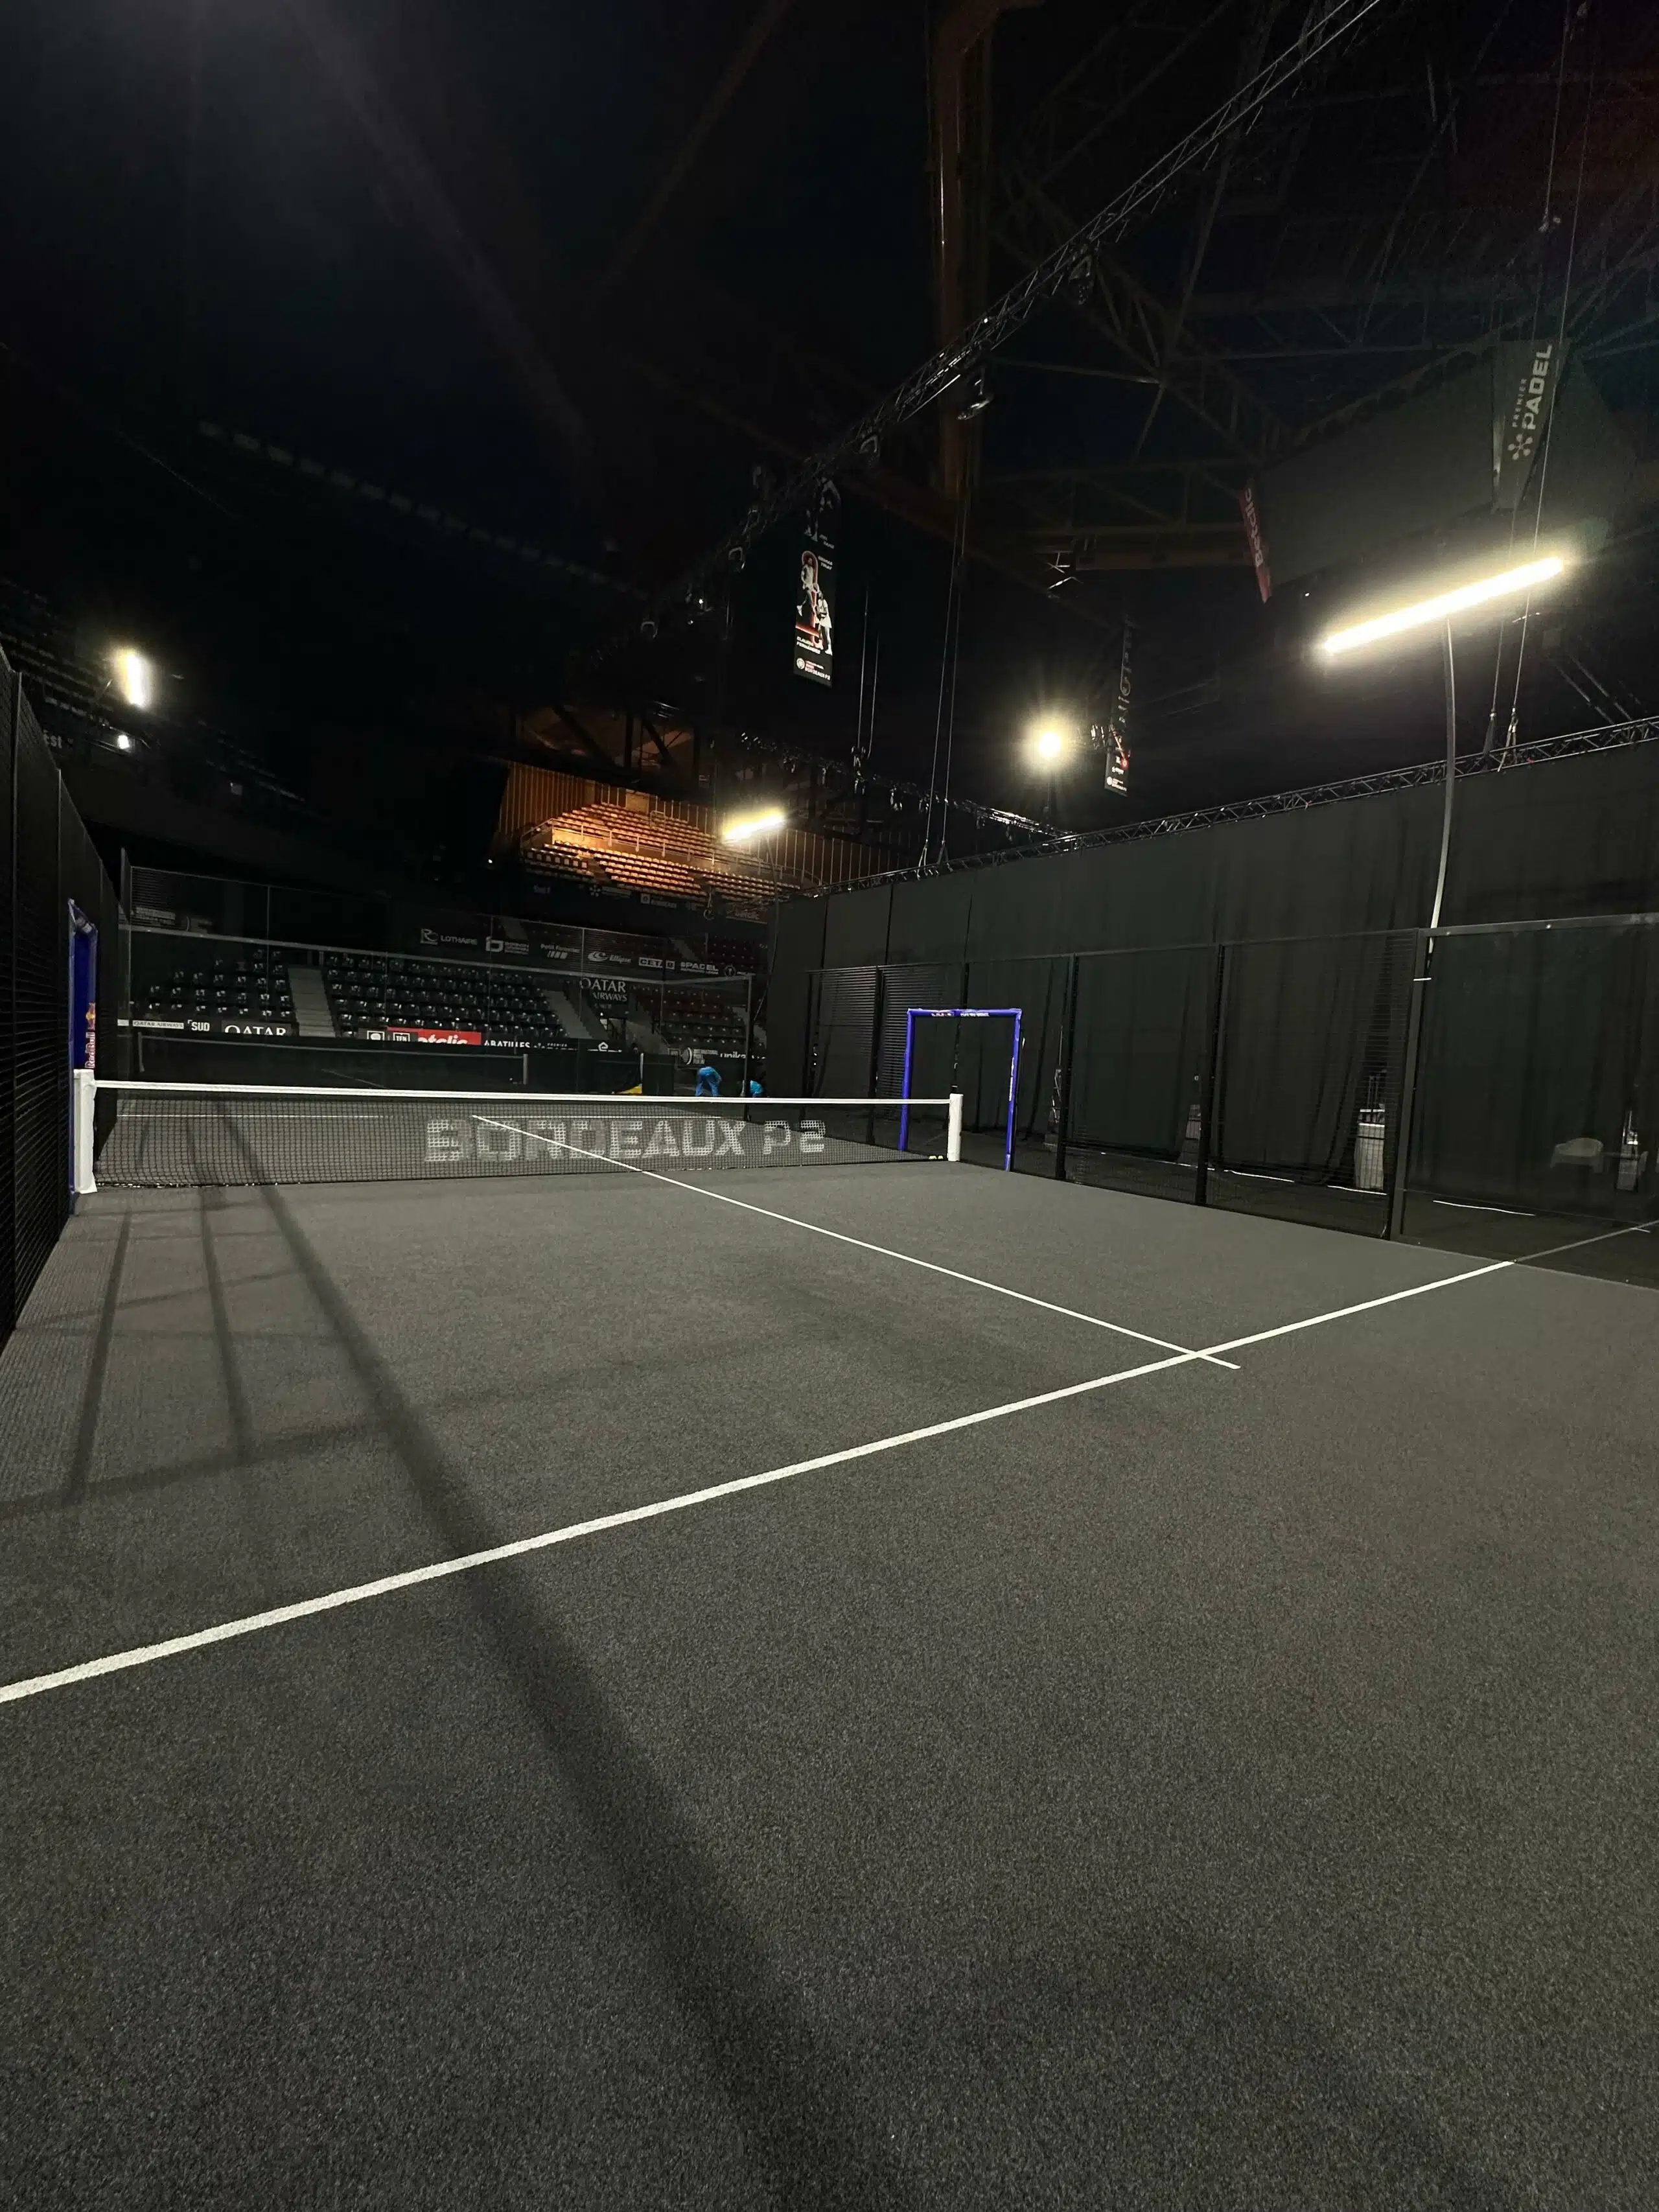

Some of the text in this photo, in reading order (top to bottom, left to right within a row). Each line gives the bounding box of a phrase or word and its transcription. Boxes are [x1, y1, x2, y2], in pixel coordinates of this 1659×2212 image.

[1521, 344, 1553, 430] PADEL
[579, 977, 627, 994] QATAR
[191, 1022, 211, 1032] SUD
[425, 1119, 826, 1161] BORDEAUX P2
